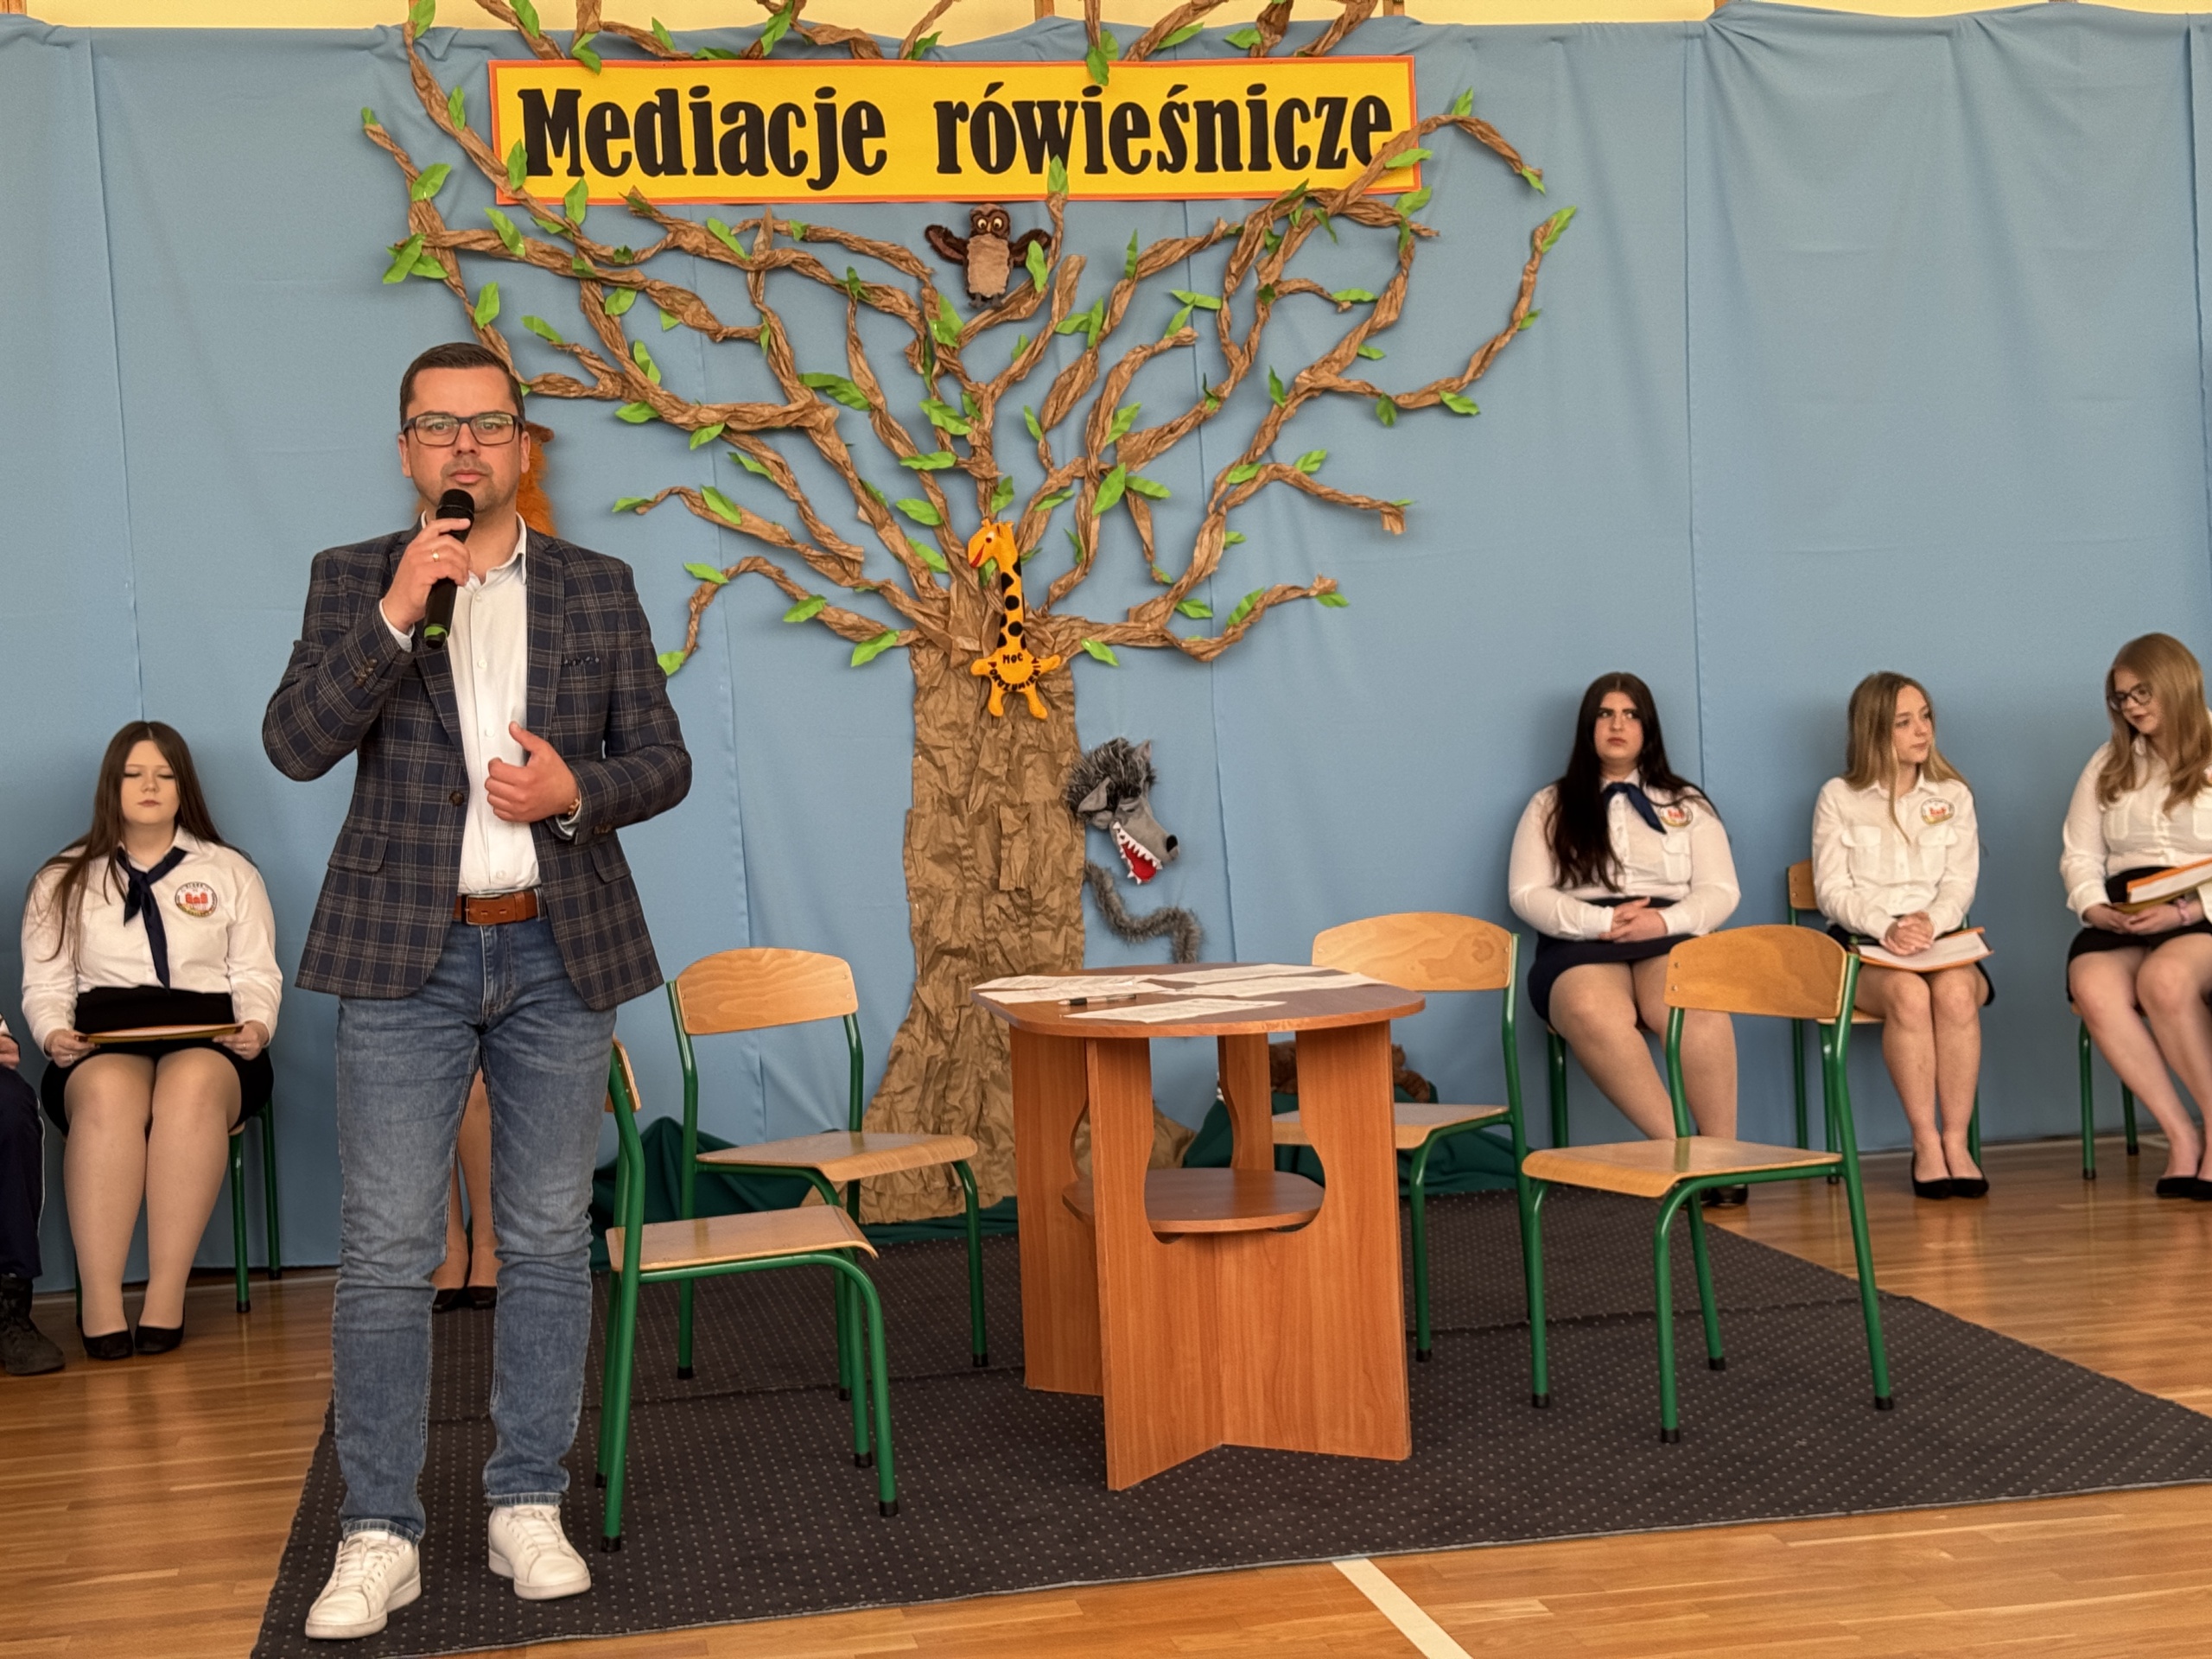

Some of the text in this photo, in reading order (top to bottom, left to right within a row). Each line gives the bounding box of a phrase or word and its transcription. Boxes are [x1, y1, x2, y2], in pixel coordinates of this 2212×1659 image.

[517, 81, 1393, 191] Mediacje rówieśnicze
[1002, 652, 1024, 664] MOC
